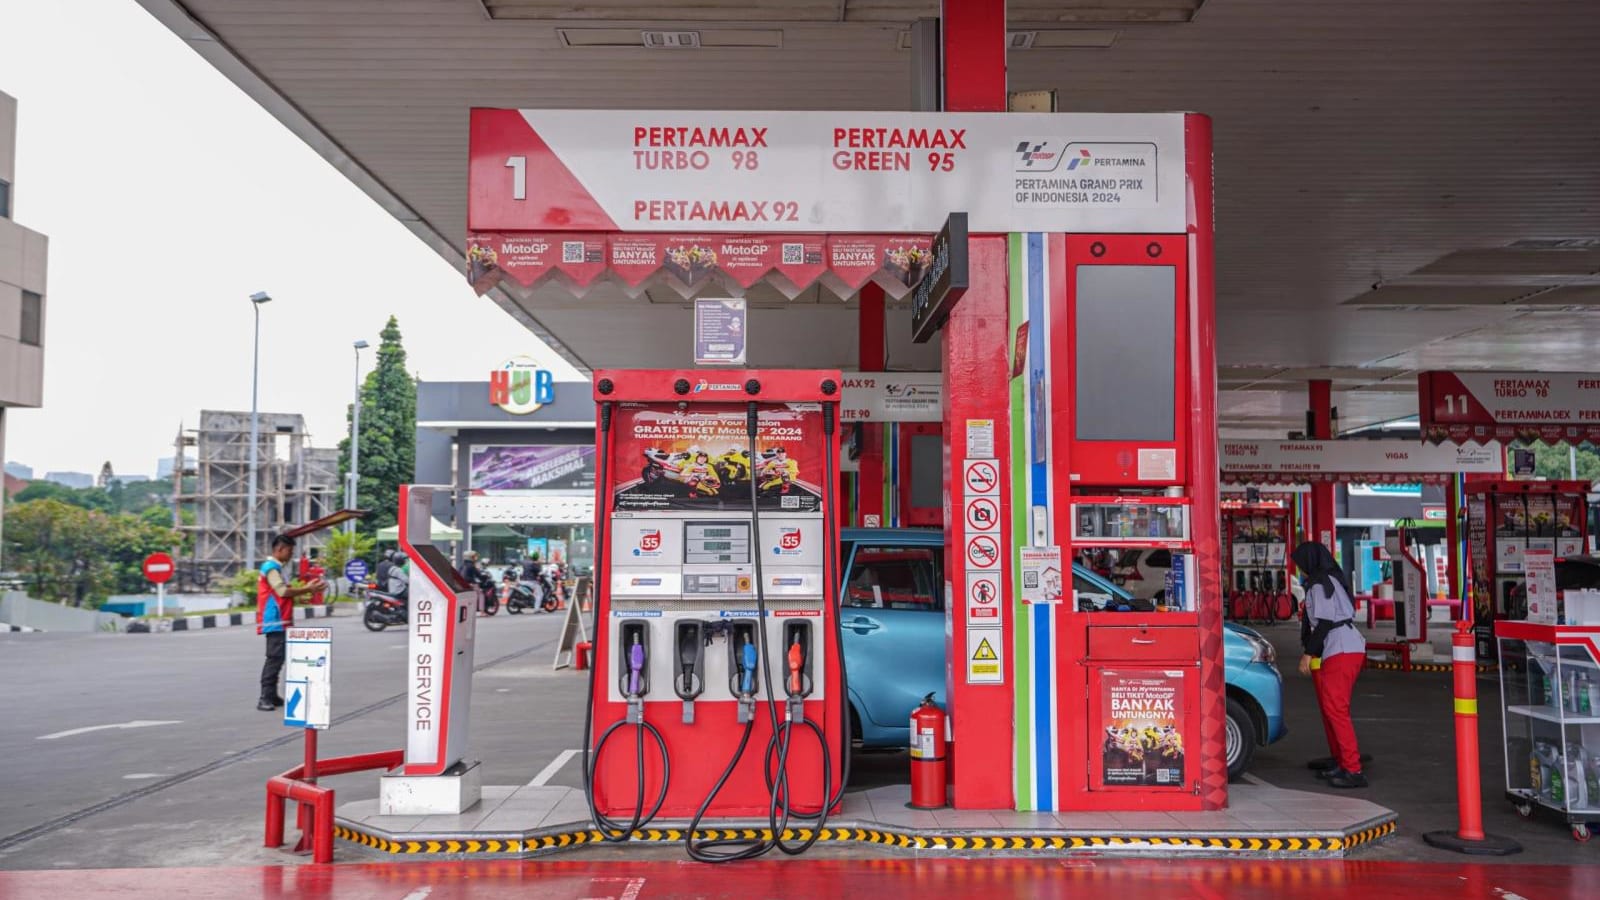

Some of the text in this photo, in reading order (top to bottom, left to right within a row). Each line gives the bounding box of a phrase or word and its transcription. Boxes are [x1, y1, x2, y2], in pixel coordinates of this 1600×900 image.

[634, 127, 768, 148] PERTAMAX
[834, 127, 967, 149] PERTAMAX
[633, 150, 759, 171] TURBO 98
[832, 150, 955, 172] GREEN 95
[1094, 158, 1146, 167] PERTAMINA
[503, 155, 527, 201] 1
[1015, 178, 1143, 190] PERTAMINA GRAND PRIX
[1015, 192, 1121, 203] OF INDONESIA 2024
[634, 200, 799, 221] PERTAMAX 92
[501, 243, 550, 254] MotoGP
[721, 244, 769, 256] MotoGP
[612, 251, 656, 259] BANYAK
[832, 252, 875, 260] BANYAK
[488, 370, 555, 406] HUB
[863, 379, 876, 388] 92
[1494, 379, 1550, 389] PERTAMAX
[1495, 388, 1548, 398] TURBO 98
[1444, 394, 1468, 415] 11
[858, 409, 870, 418] 90
[1494, 410, 1571, 420] PERTAMINA DEX
[719, 419, 744, 427] Your
[634, 426, 681, 434] GRATIS
[682, 426, 715, 435] TIKET
[769, 427, 803, 436] 2024
[1385, 452, 1409, 460] VIGAS
[530, 457, 586, 488] MAKSIMAL
[417, 600, 432, 643] SELF
[416, 653, 432, 731] SERVICE
[1111, 699, 1175, 710] BANYAK
[1111, 710, 1175, 719] UNTUNGNYA
